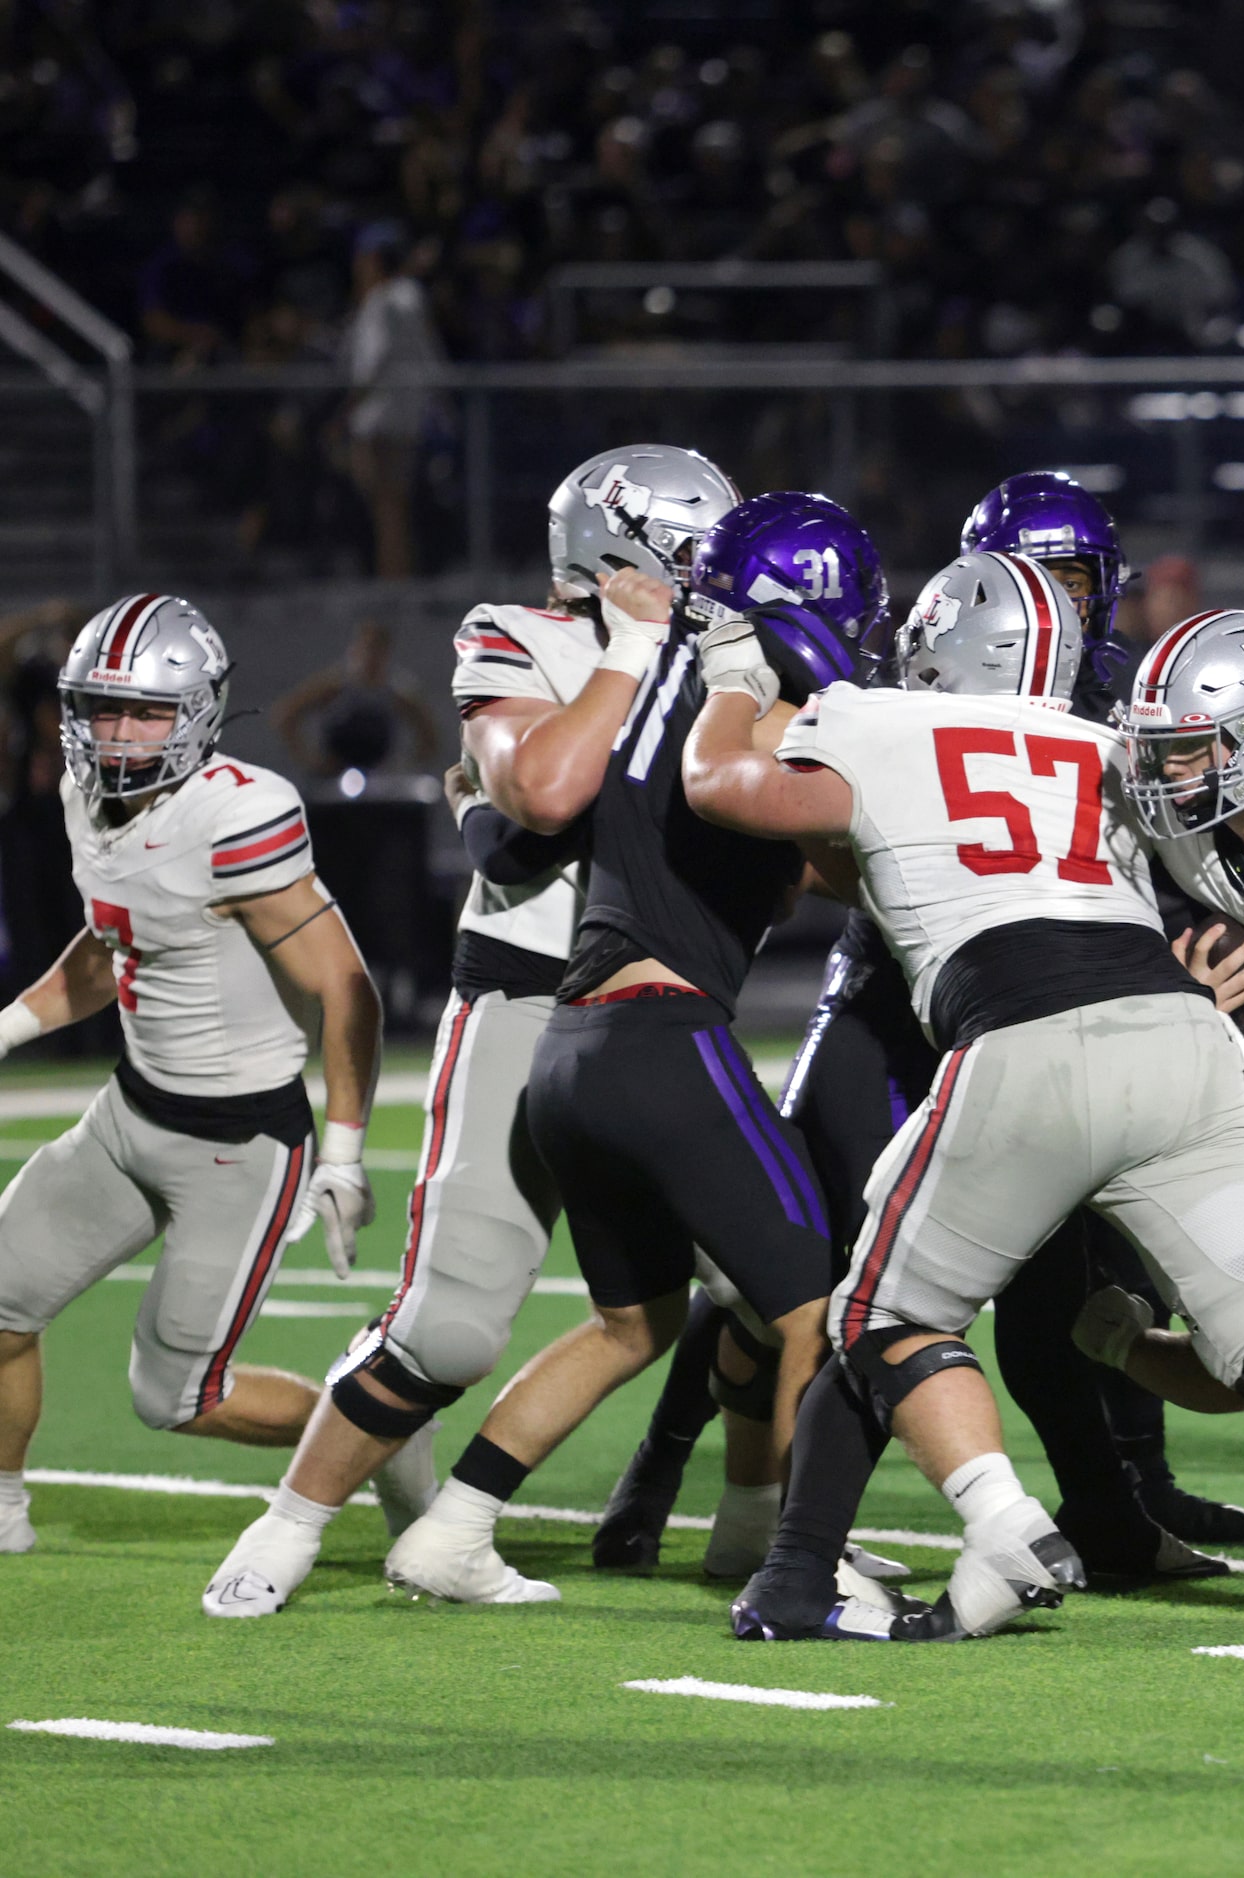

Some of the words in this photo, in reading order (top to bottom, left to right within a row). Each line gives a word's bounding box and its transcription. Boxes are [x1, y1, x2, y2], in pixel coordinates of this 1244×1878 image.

[791, 547, 843, 600] 31
[91, 671, 132, 683] Riddell
[1132, 703, 1164, 717] Riddell
[202, 764, 255, 788] 7
[933, 727, 1113, 885] 57
[91, 897, 142, 1014] 7
